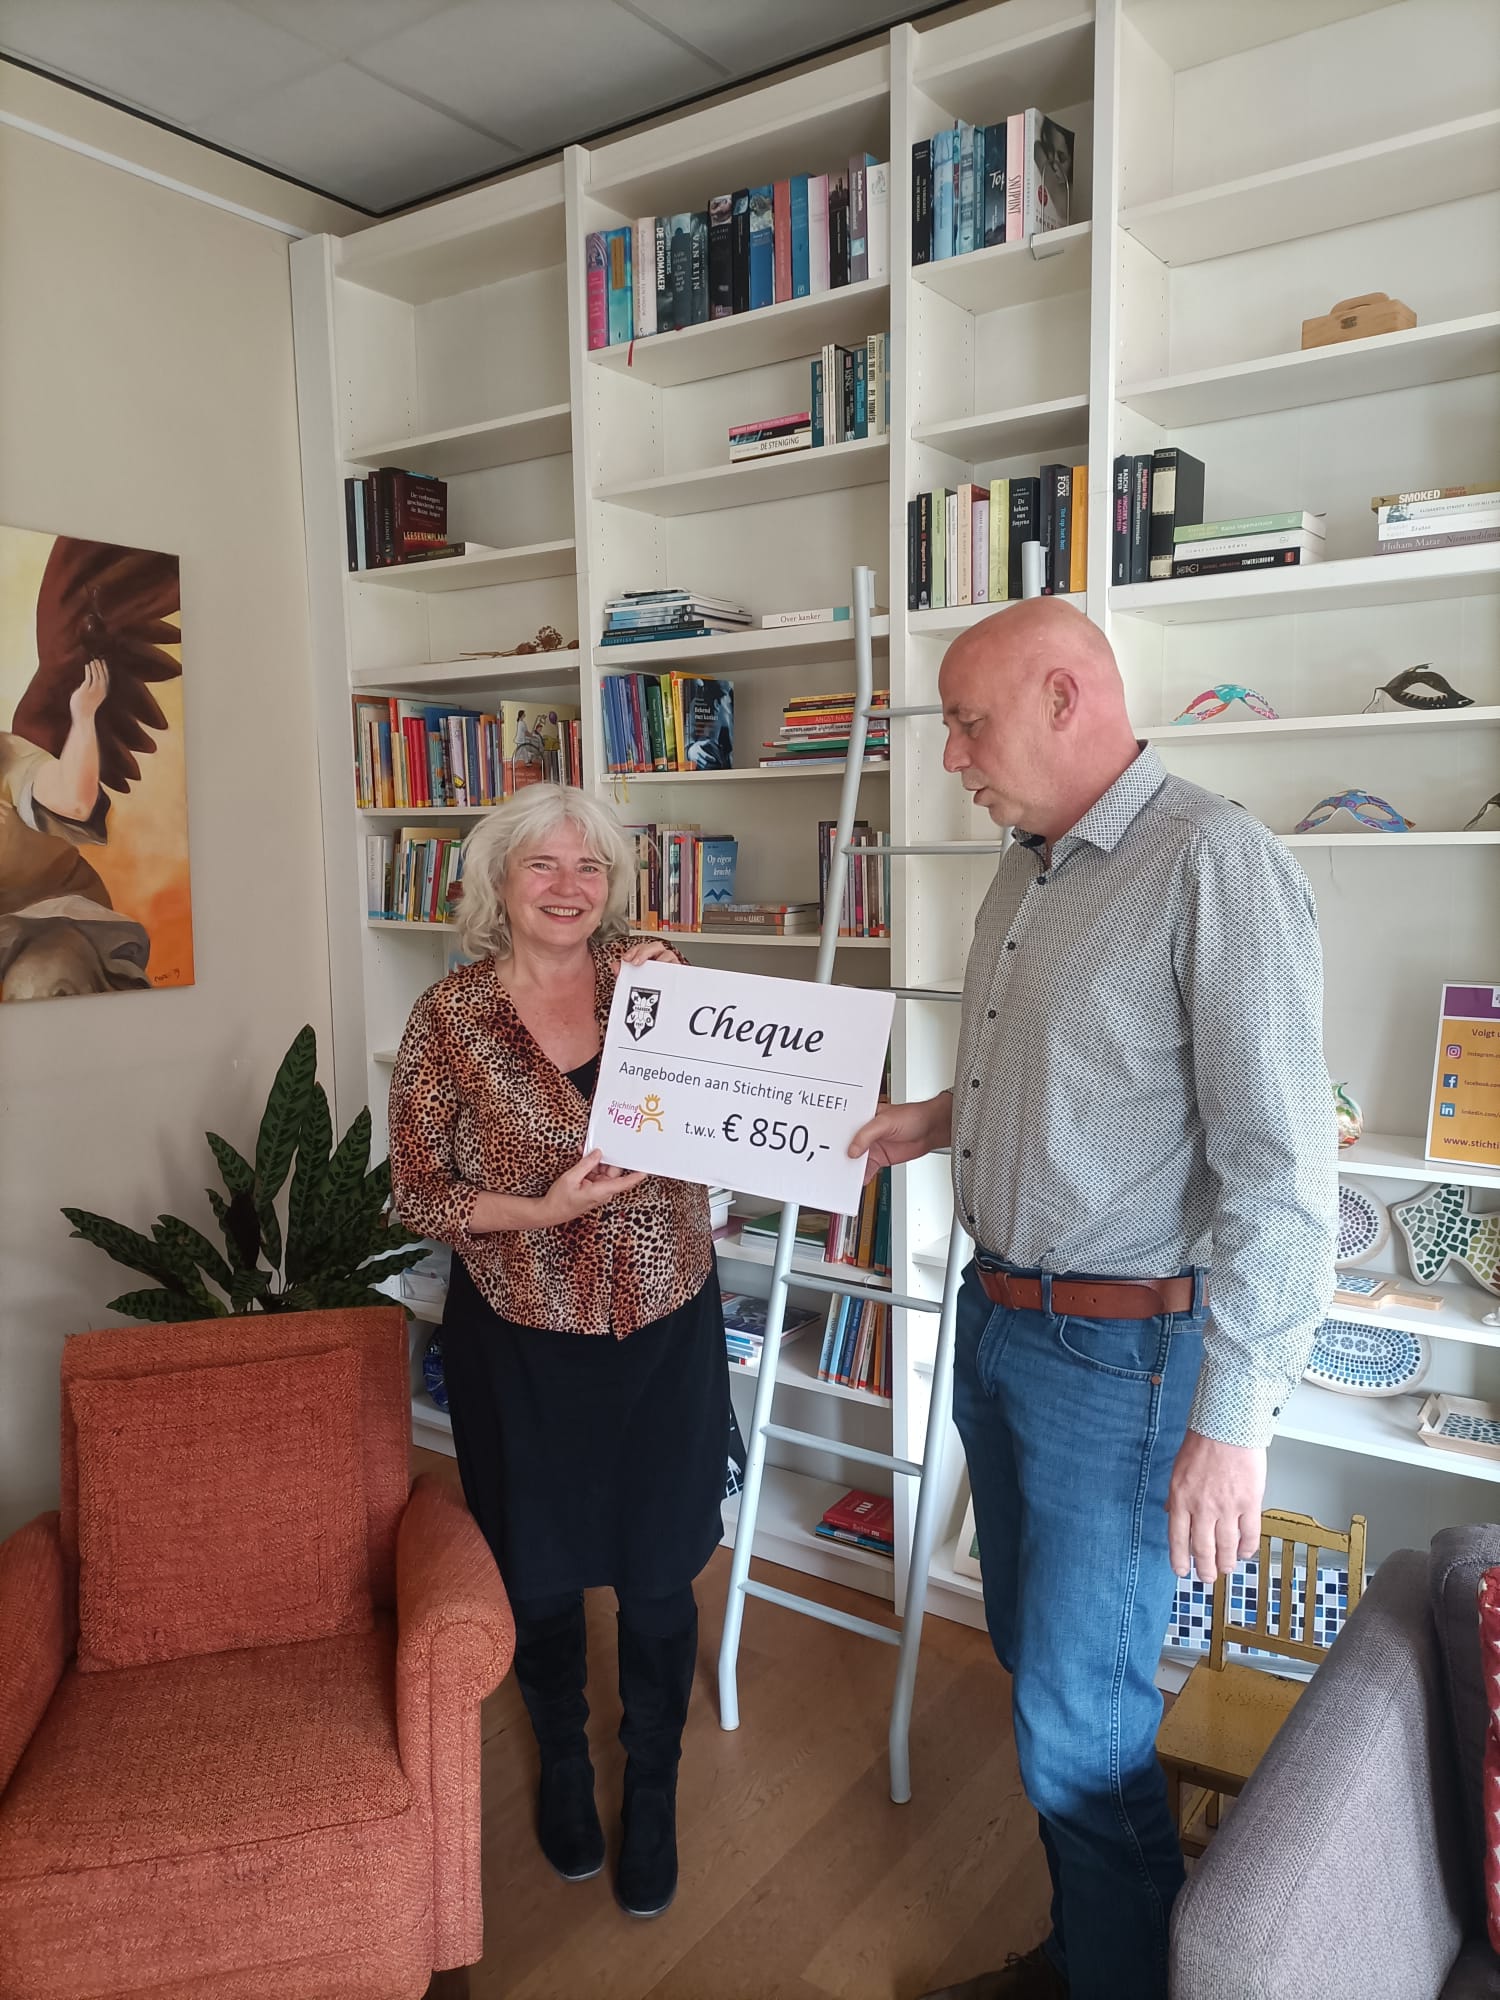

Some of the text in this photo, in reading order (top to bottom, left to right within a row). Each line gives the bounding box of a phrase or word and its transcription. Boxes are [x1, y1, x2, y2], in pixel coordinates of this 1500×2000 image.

[656, 227, 666, 291] DE ECHOMAKER
[692, 234, 701, 290] VAN RIJN
[760, 436, 800, 451] DE STENIGING
[1057, 475, 1066, 497] FOX
[1398, 489, 1441, 504] SMOKED
[1415, 537, 1441, 547] Matar
[780, 612, 821, 623] Over kanker
[815, 715, 834, 724] ANGST
[707, 854, 716, 866] Op
[688, 1005, 824, 1057] Cheque
[1472, 1029, 1496, 1039] Volgt
[619, 1061, 701, 1088] Aangeboden
[705, 1077, 730, 1092] aan
[732, 1080, 793, 1105] Stichting
[611, 1100, 639, 1114] Stichting
[684, 1113, 831, 1162] t.w.v. € 850,-
